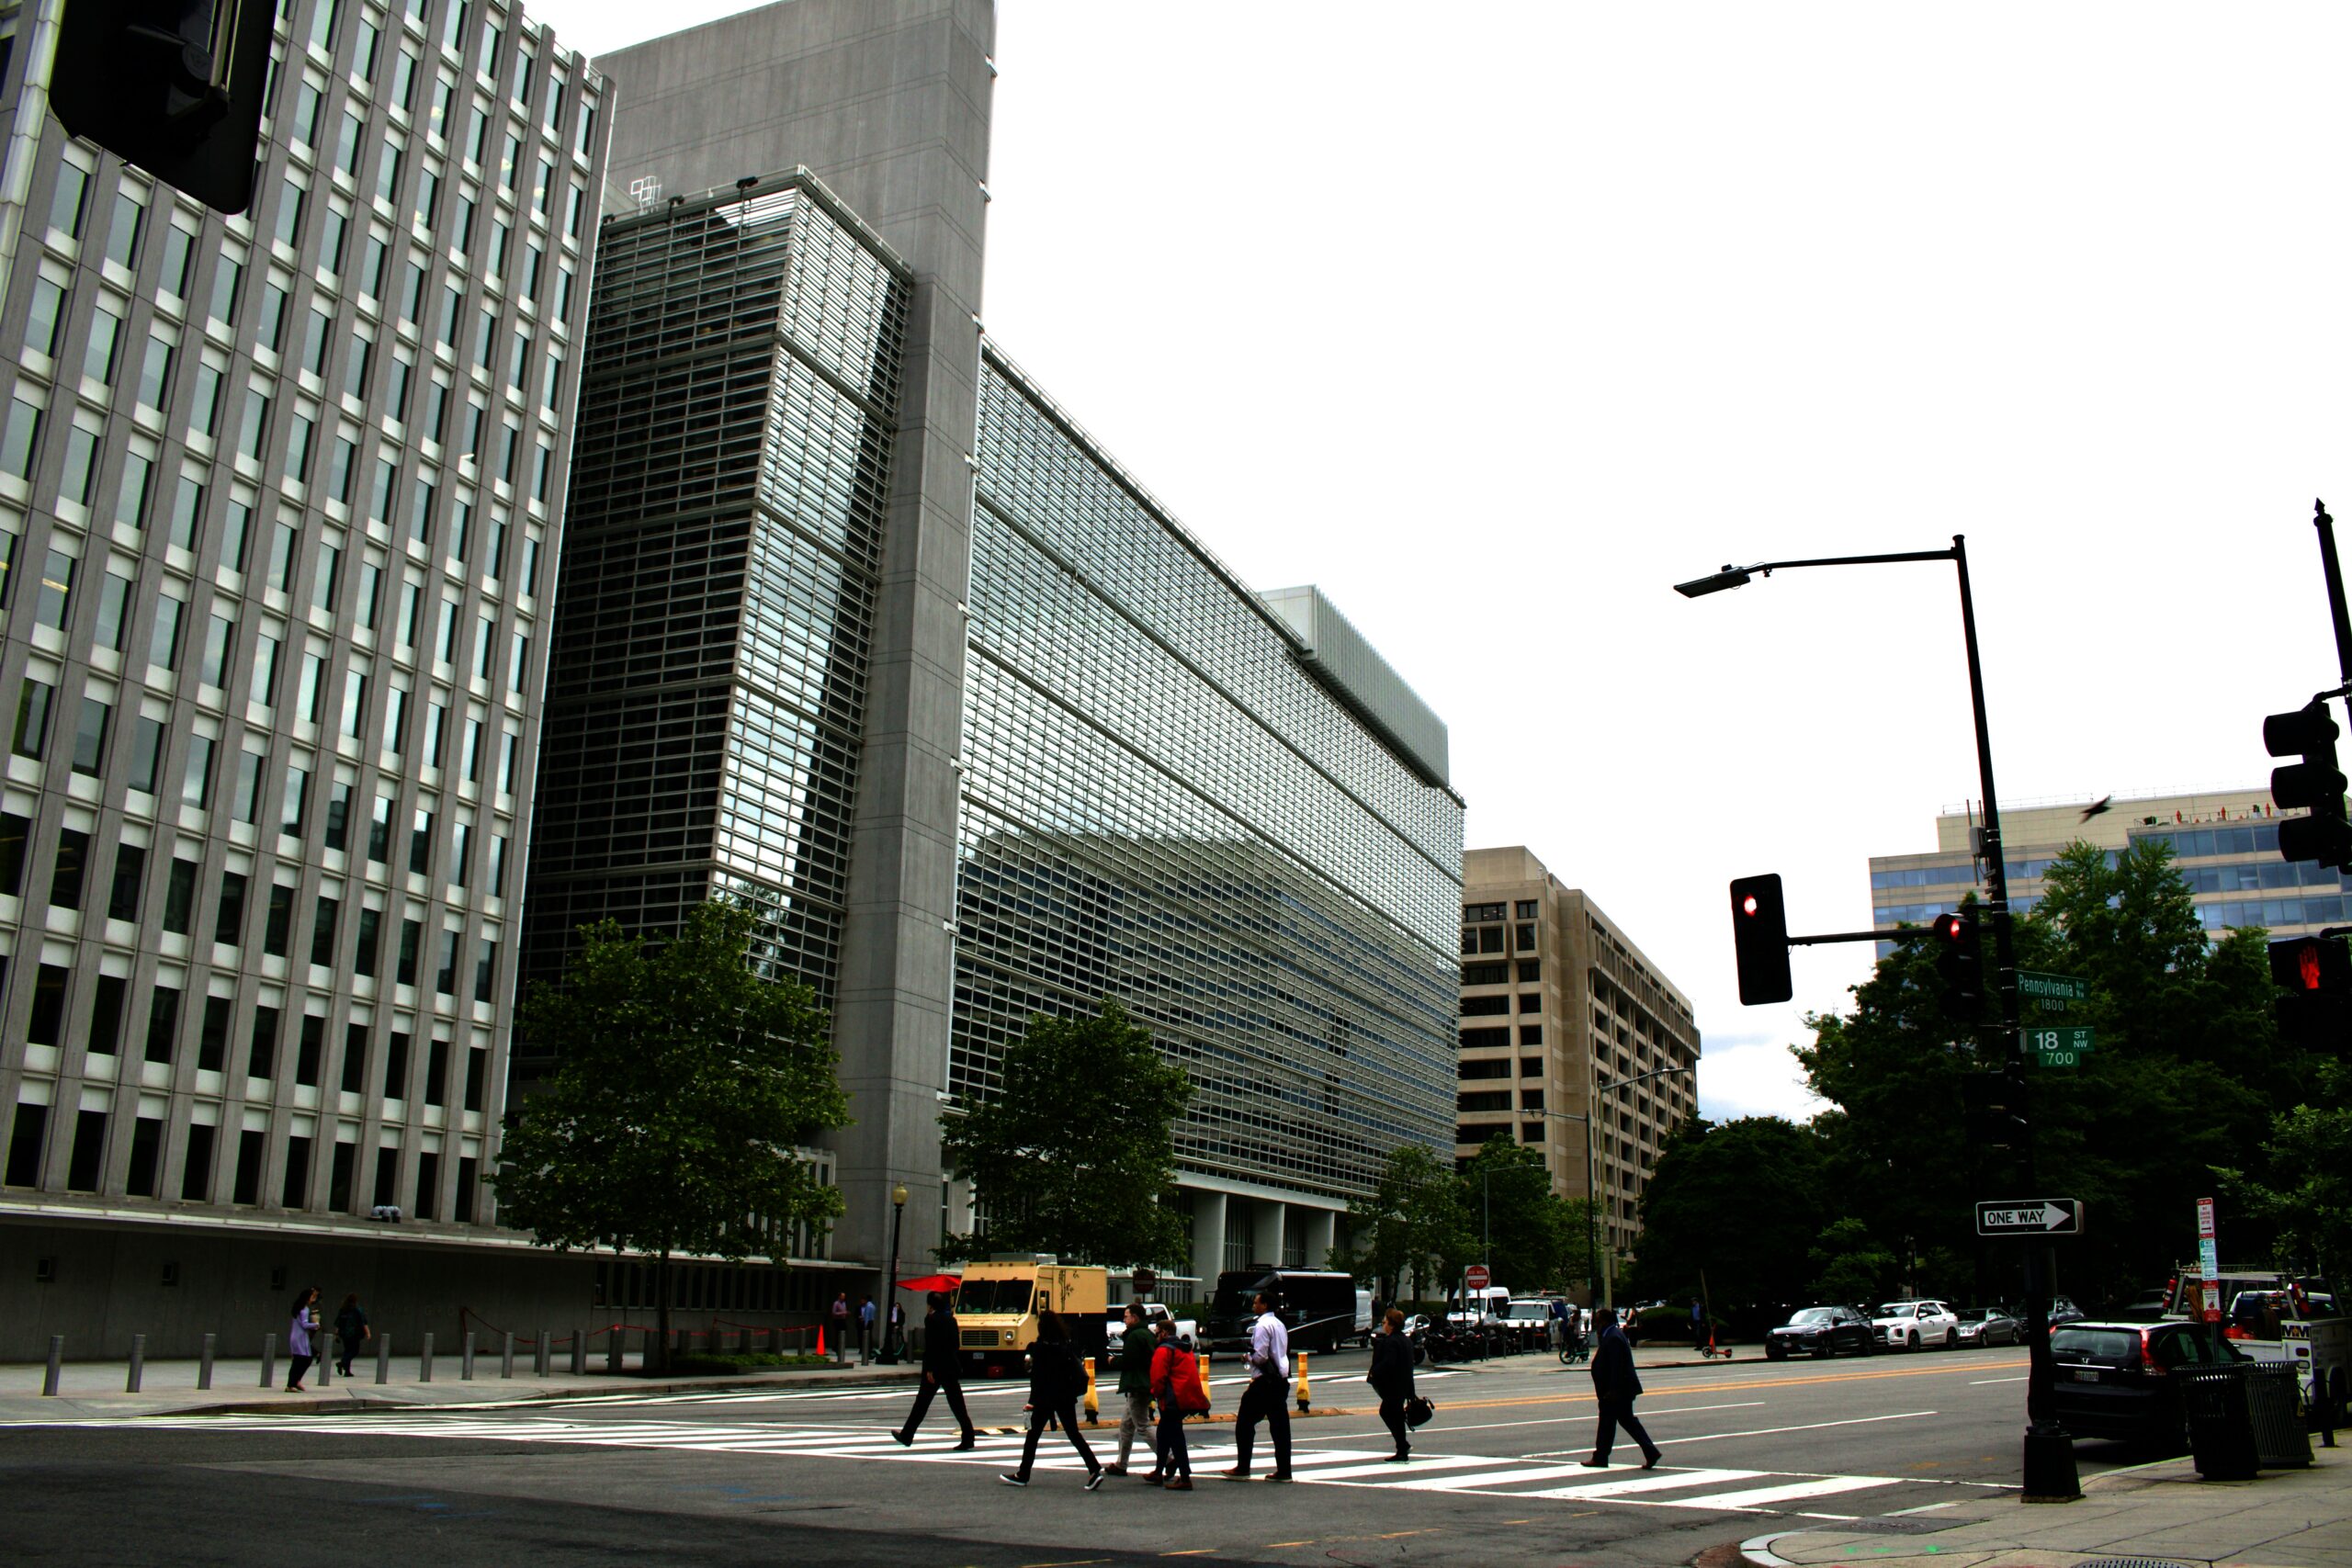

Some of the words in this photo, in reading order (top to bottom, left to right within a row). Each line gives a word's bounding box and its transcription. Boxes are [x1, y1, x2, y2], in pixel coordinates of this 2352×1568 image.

[2018, 975, 2074, 998] Pennsylvania
[2041, 998, 2064, 1011] 1800
[2034, 1032, 2059, 1050] 18
[2074, 1031, 2087, 1039] ST
[2073, 1040, 2088, 1048] NW
[2046, 1052, 2074, 1065] 700
[1987, 1212, 2014, 1224] ONE
[2018, 1210, 2045, 1224] WAY
